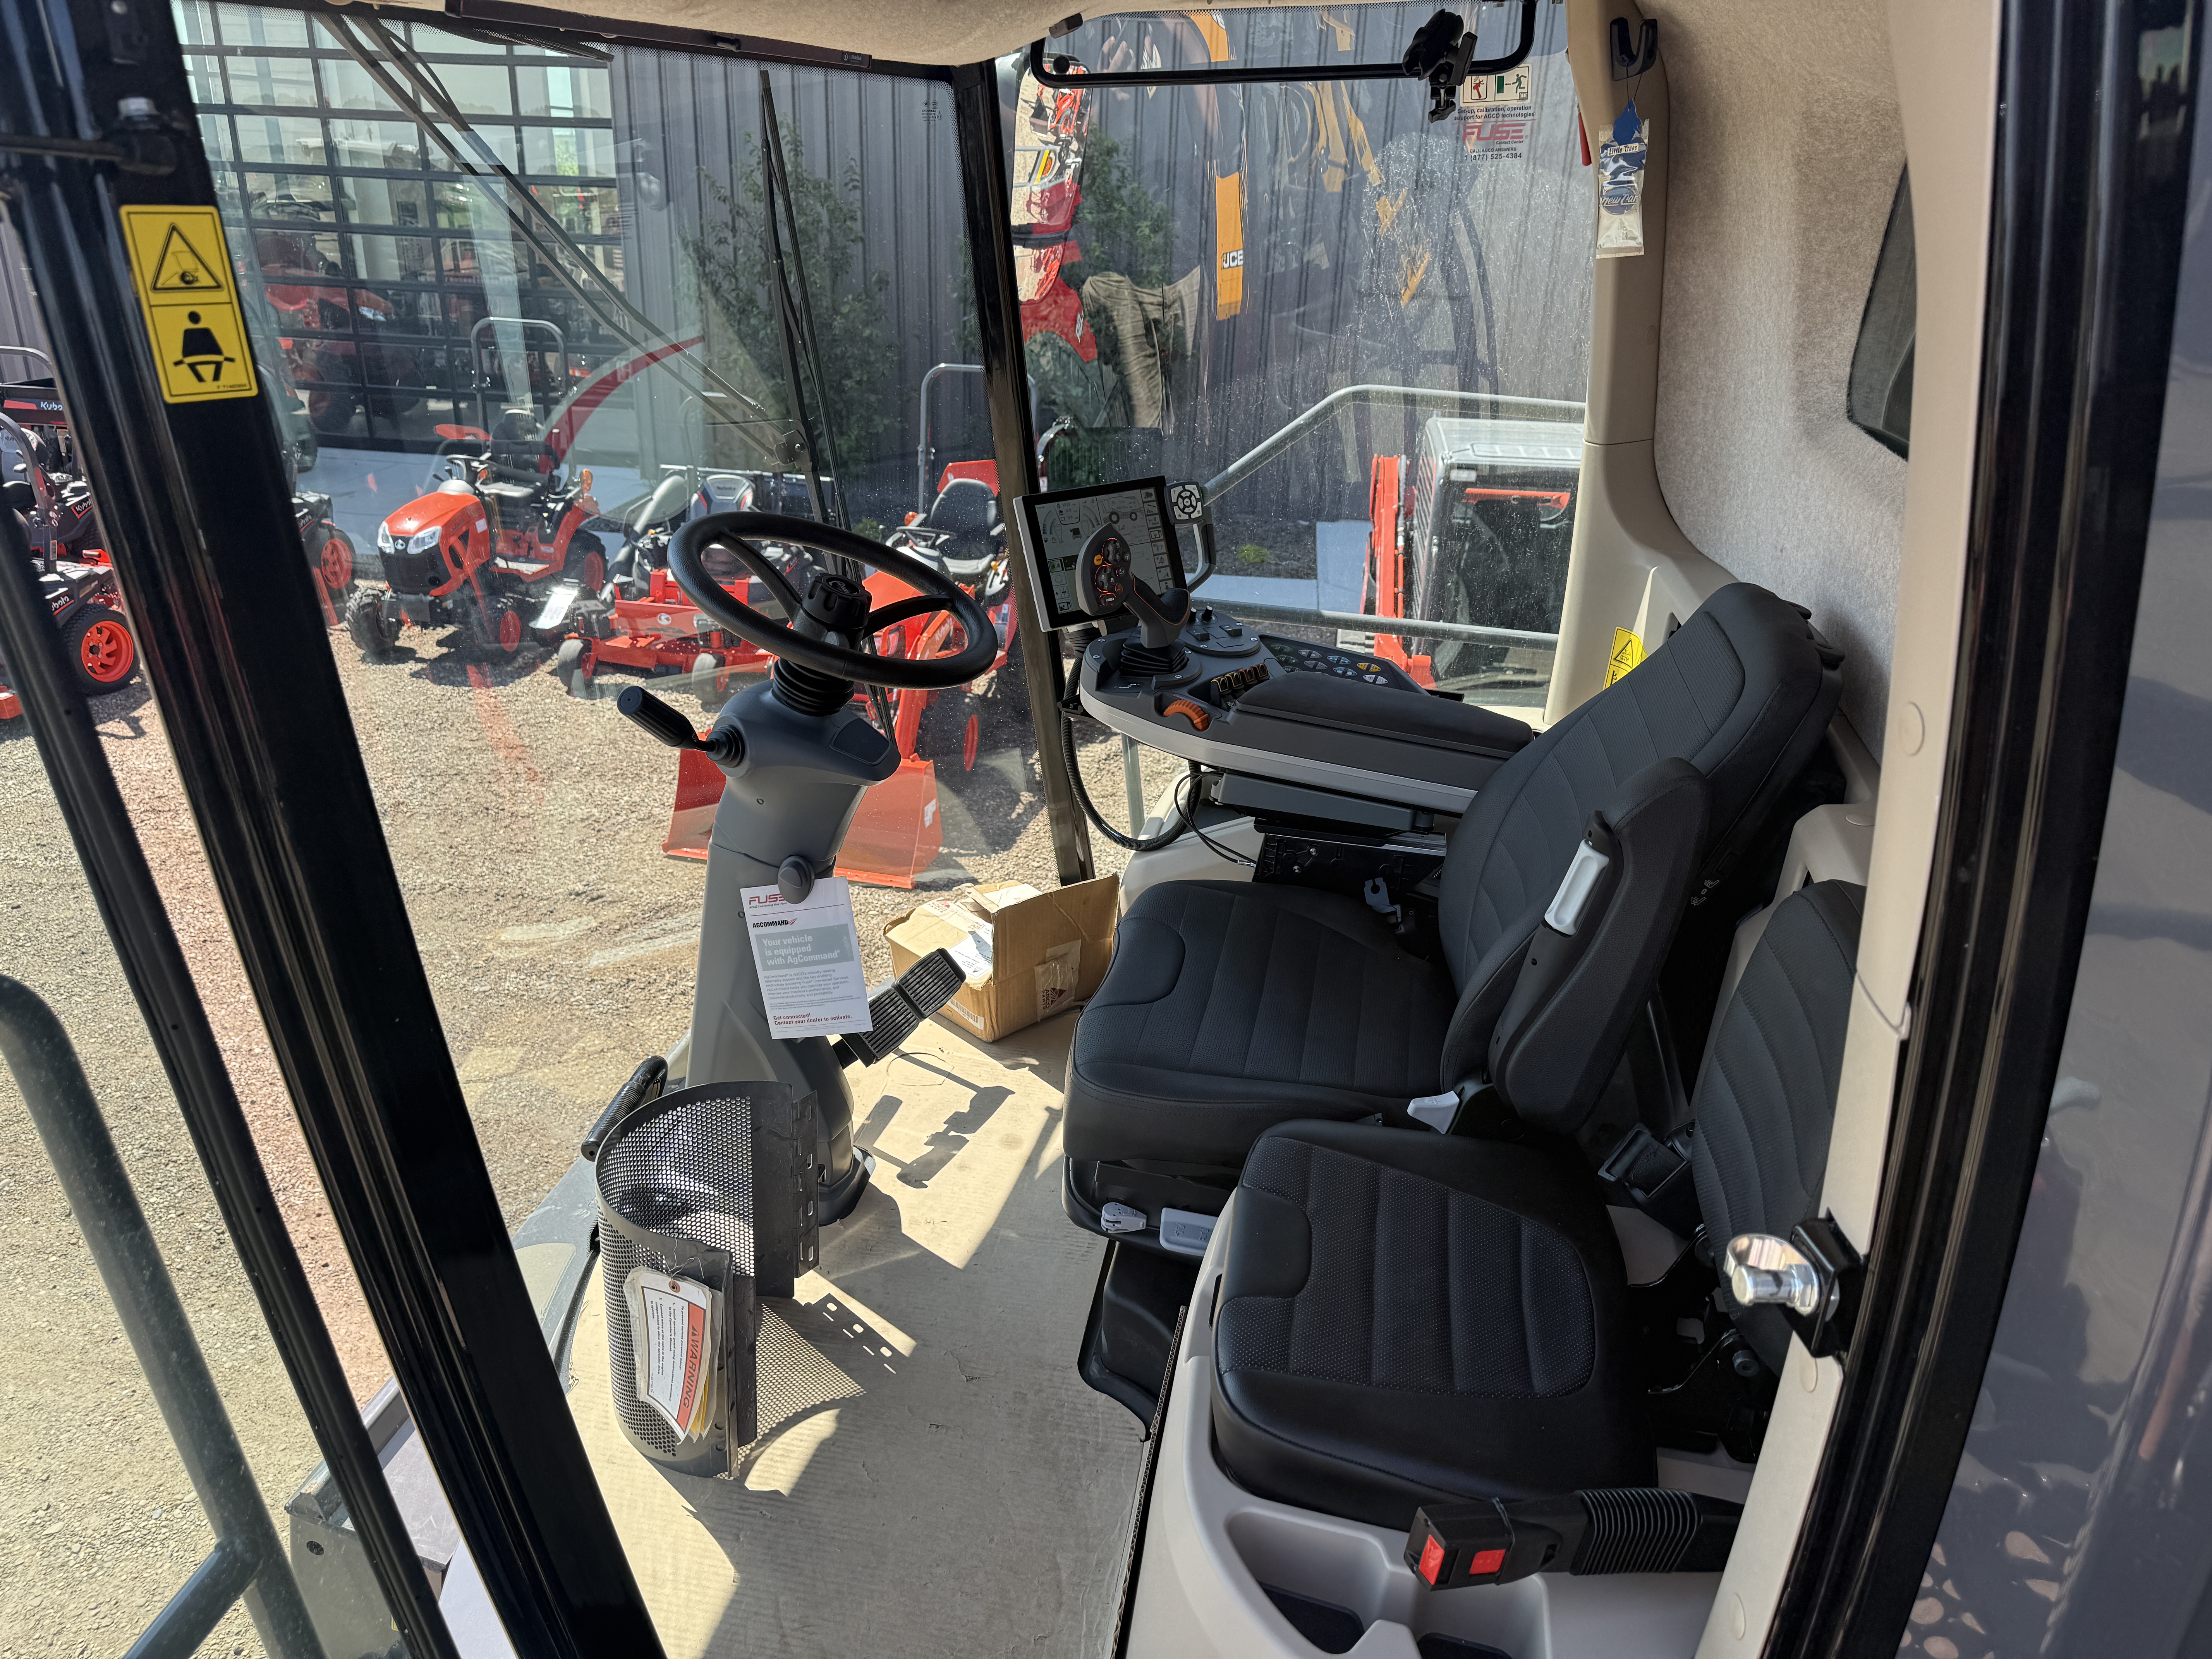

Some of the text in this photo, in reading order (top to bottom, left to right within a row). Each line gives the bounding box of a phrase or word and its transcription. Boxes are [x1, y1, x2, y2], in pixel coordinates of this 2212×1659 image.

[41, 401, 63, 410] Kubo
[753, 920, 788, 928] AGCOMMAND
[783, 934, 812, 945] vehicle
[774, 944, 811, 956] equipped
[684, 1339, 699, 1408] WARNING
